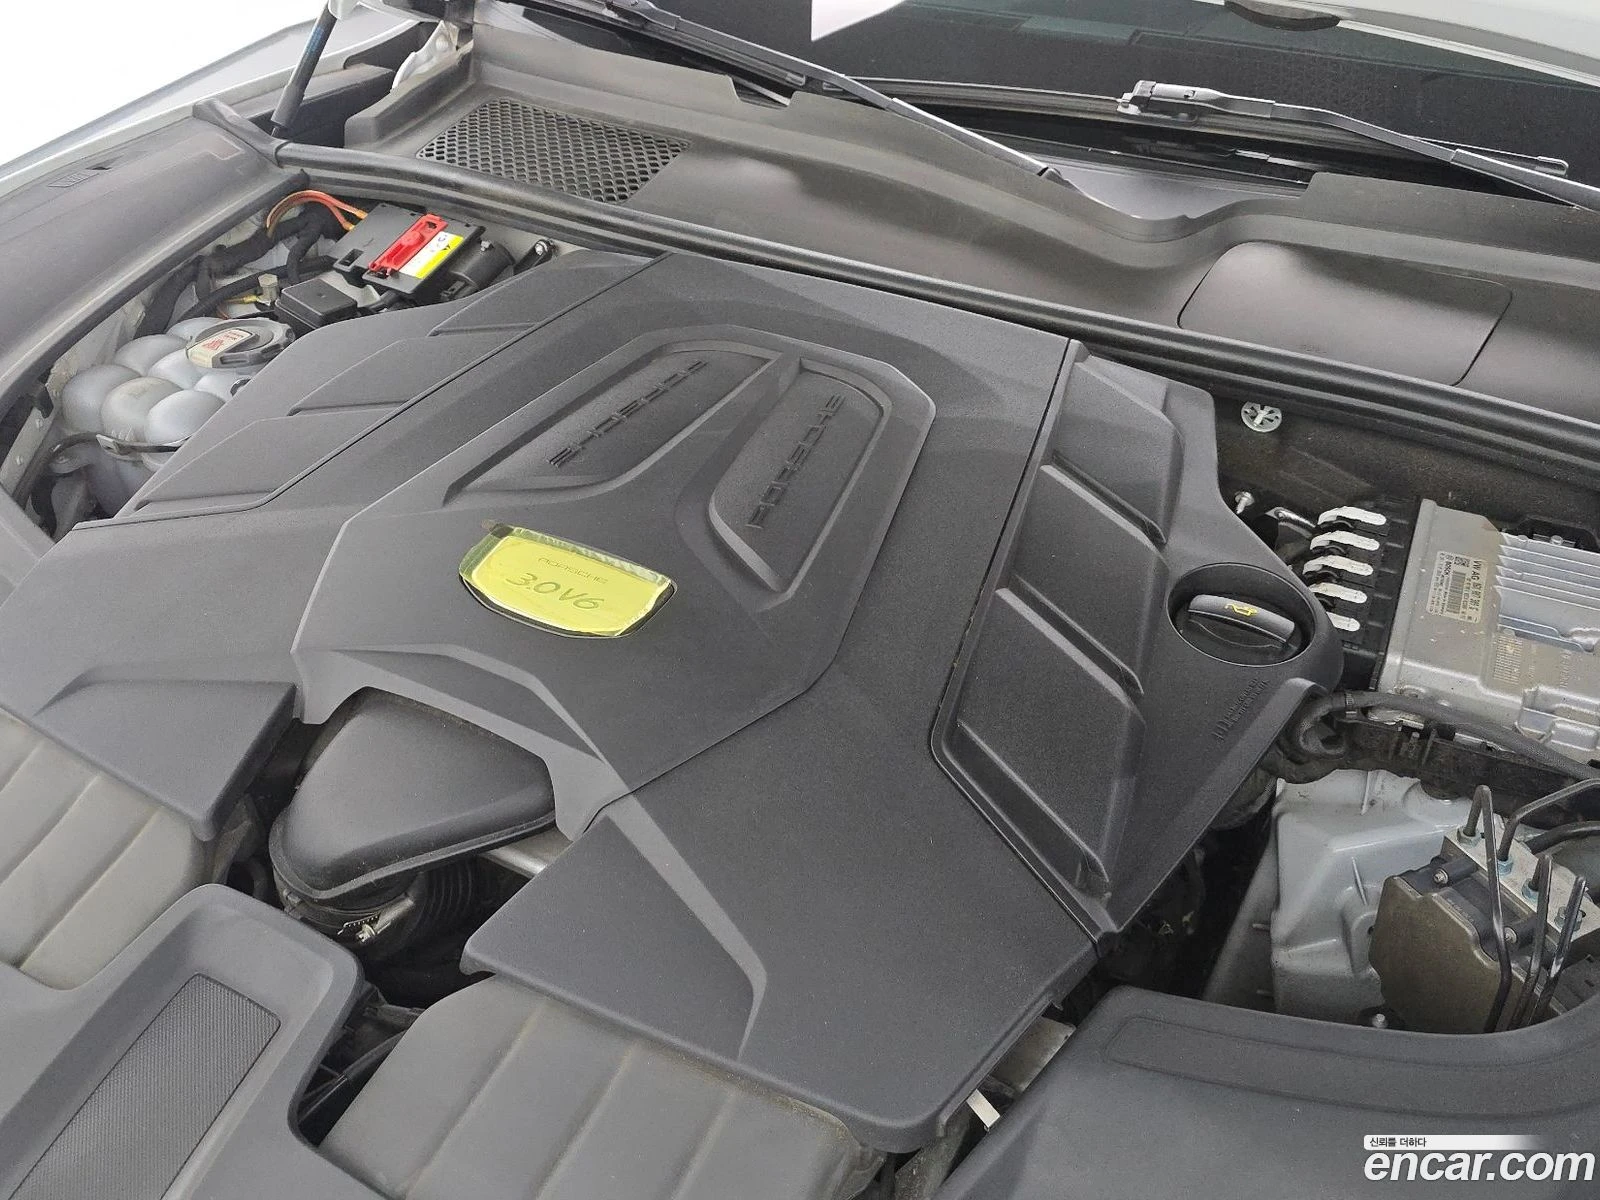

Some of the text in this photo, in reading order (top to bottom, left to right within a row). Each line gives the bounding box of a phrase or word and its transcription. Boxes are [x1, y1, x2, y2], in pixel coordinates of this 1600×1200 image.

[547, 360, 709, 469] PORSCHE
[746, 394, 847, 530] PORSCHE
[505, 572, 606, 610] 3.0 V6
[536, 556, 609, 585] PORSCHE
